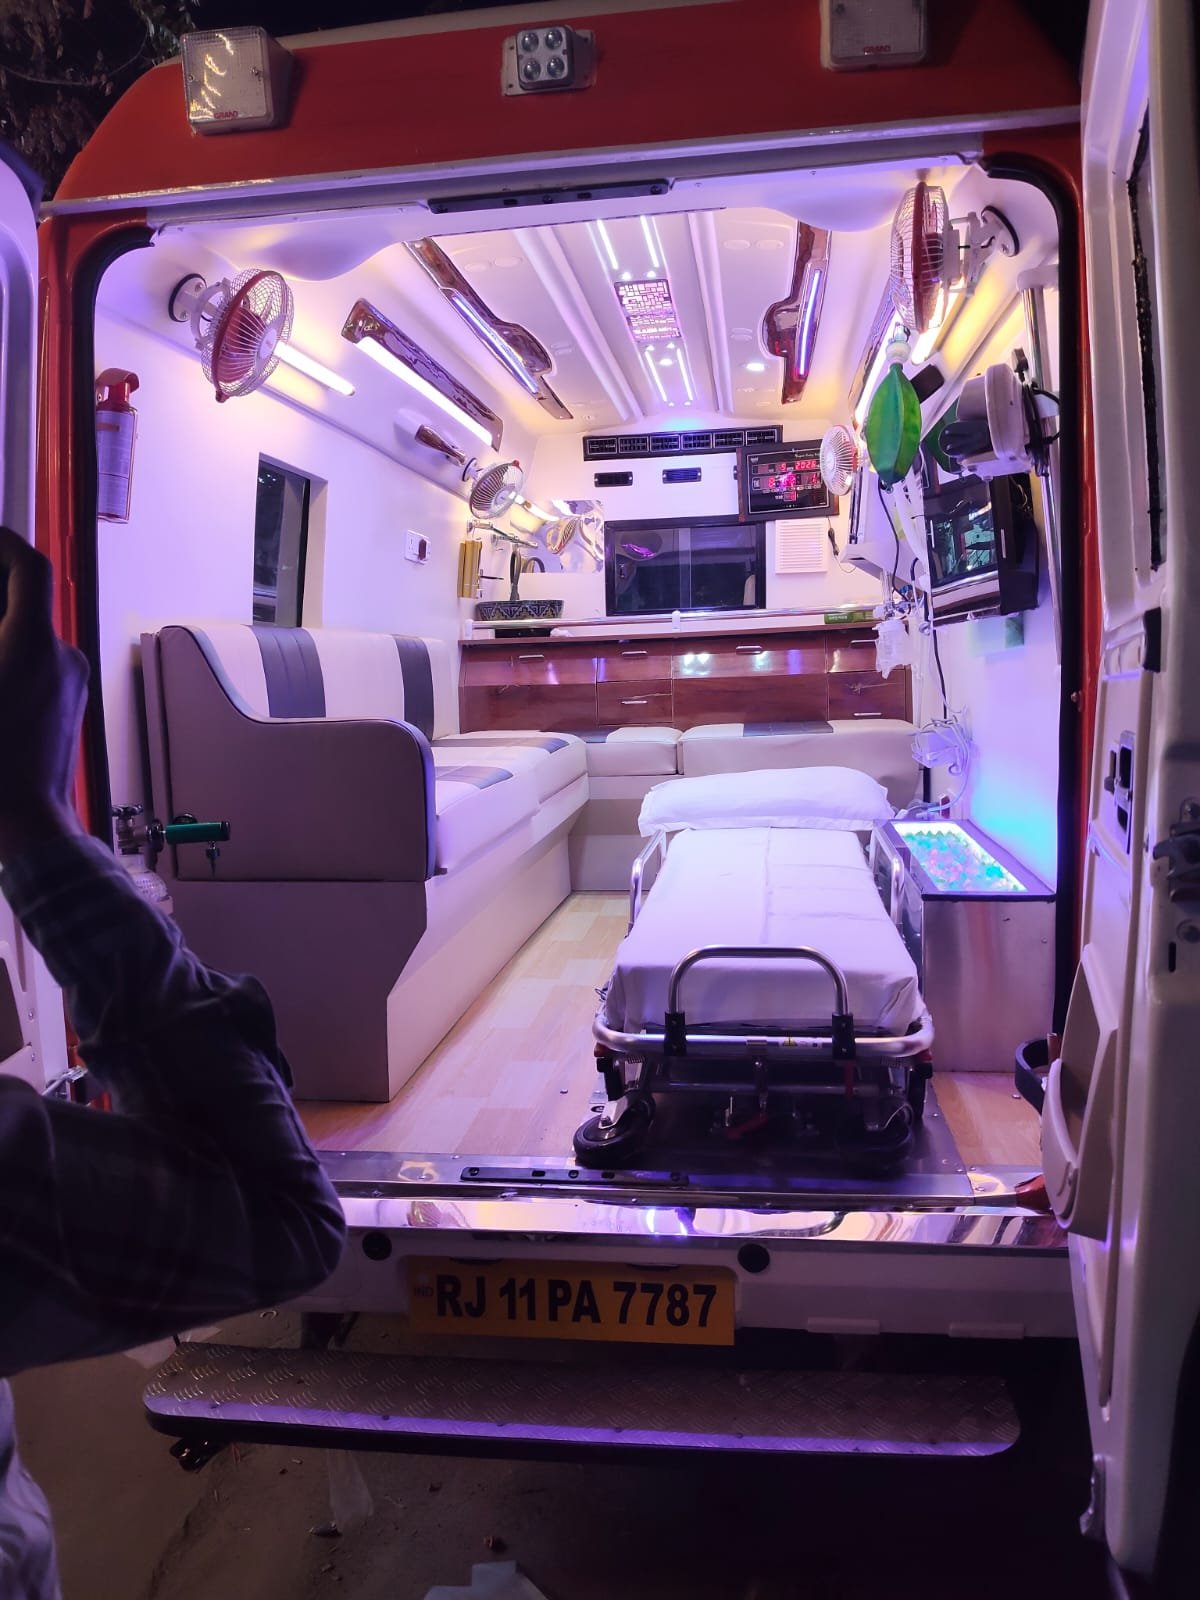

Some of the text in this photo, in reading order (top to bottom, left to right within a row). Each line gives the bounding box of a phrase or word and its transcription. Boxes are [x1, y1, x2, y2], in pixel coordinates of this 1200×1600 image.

[413, 1286, 433, 1297] IND
[436, 1274, 717, 1327] RJ 11 PA 7787
